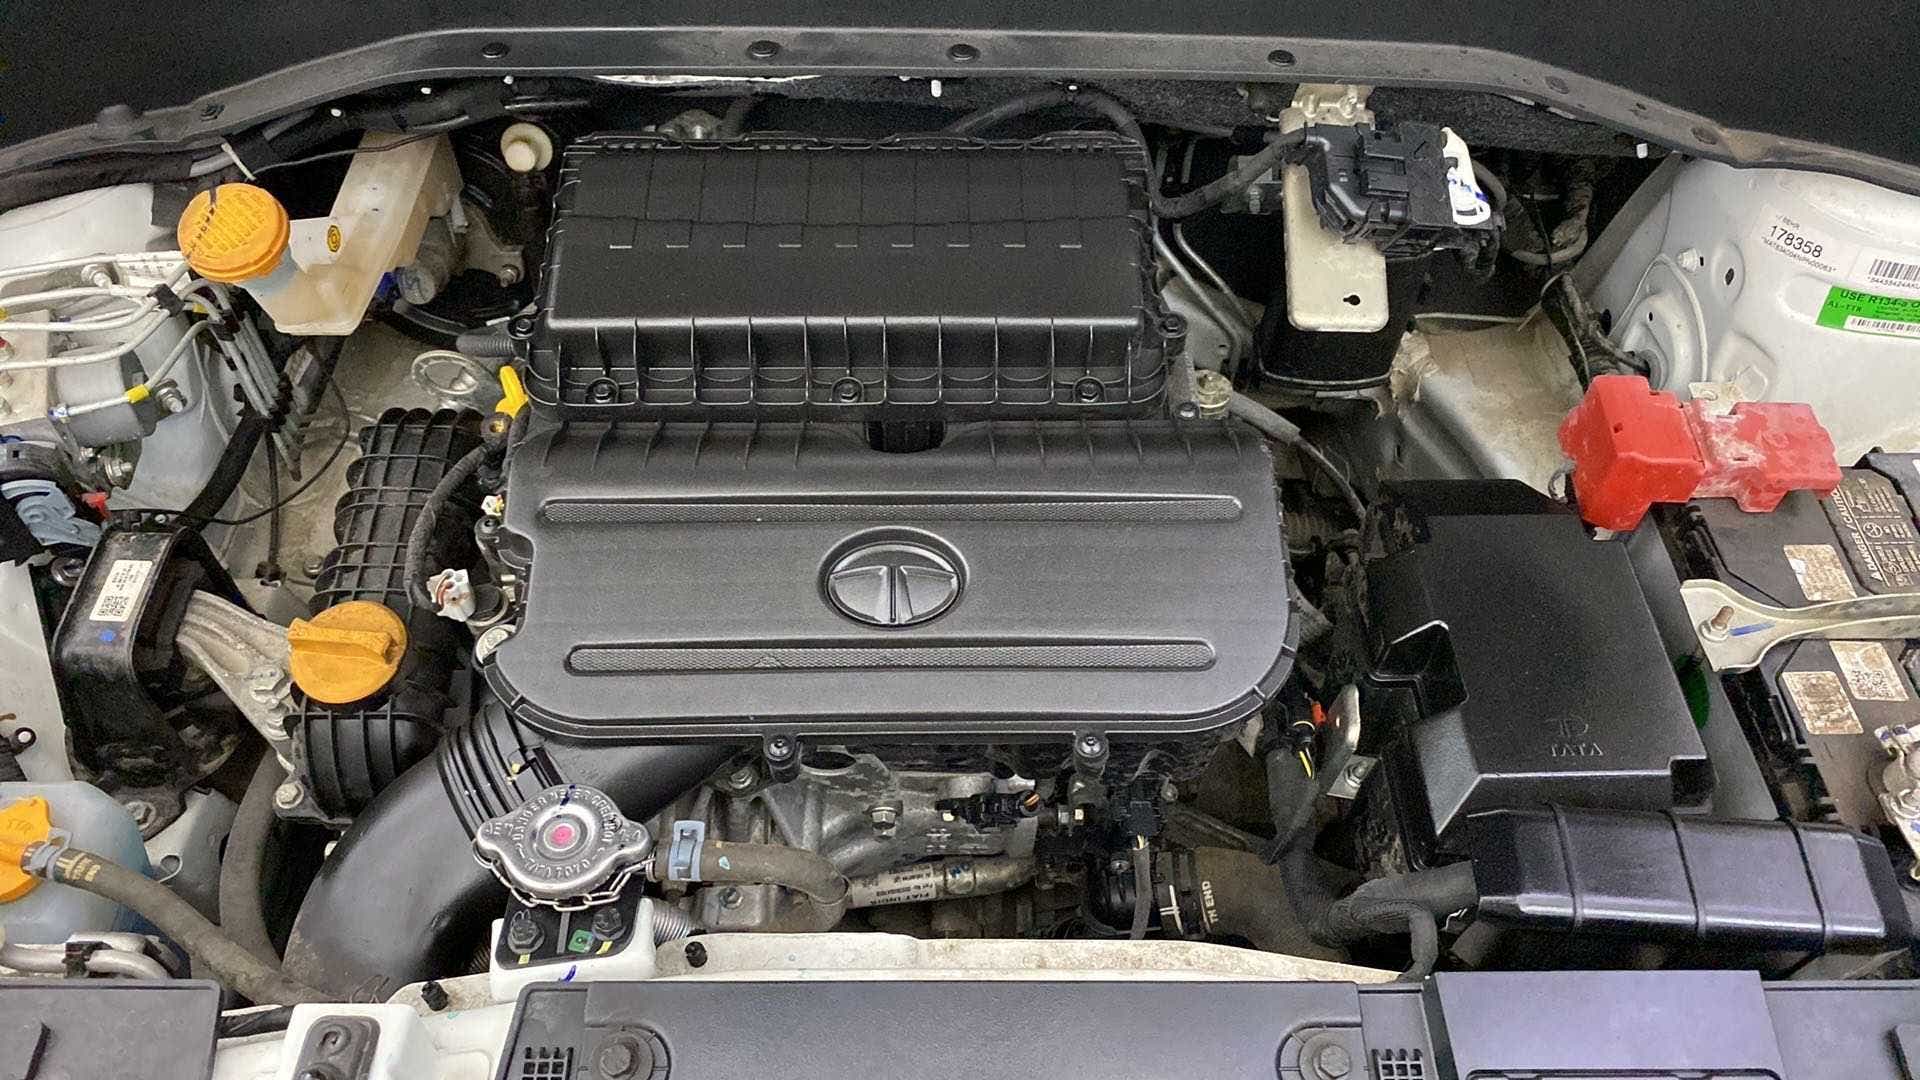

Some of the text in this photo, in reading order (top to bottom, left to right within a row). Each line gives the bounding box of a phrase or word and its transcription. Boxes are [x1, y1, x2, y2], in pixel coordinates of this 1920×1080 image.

[1769, 225, 1823, 258] 178358
[1840, 289, 1866, 302] USE
[1830, 487, 1853, 524] CAUTIO
[1851, 531, 1878, 571] DANGER
[1551, 742, 1603, 757] TATA
[1201, 880, 1215, 908] END
